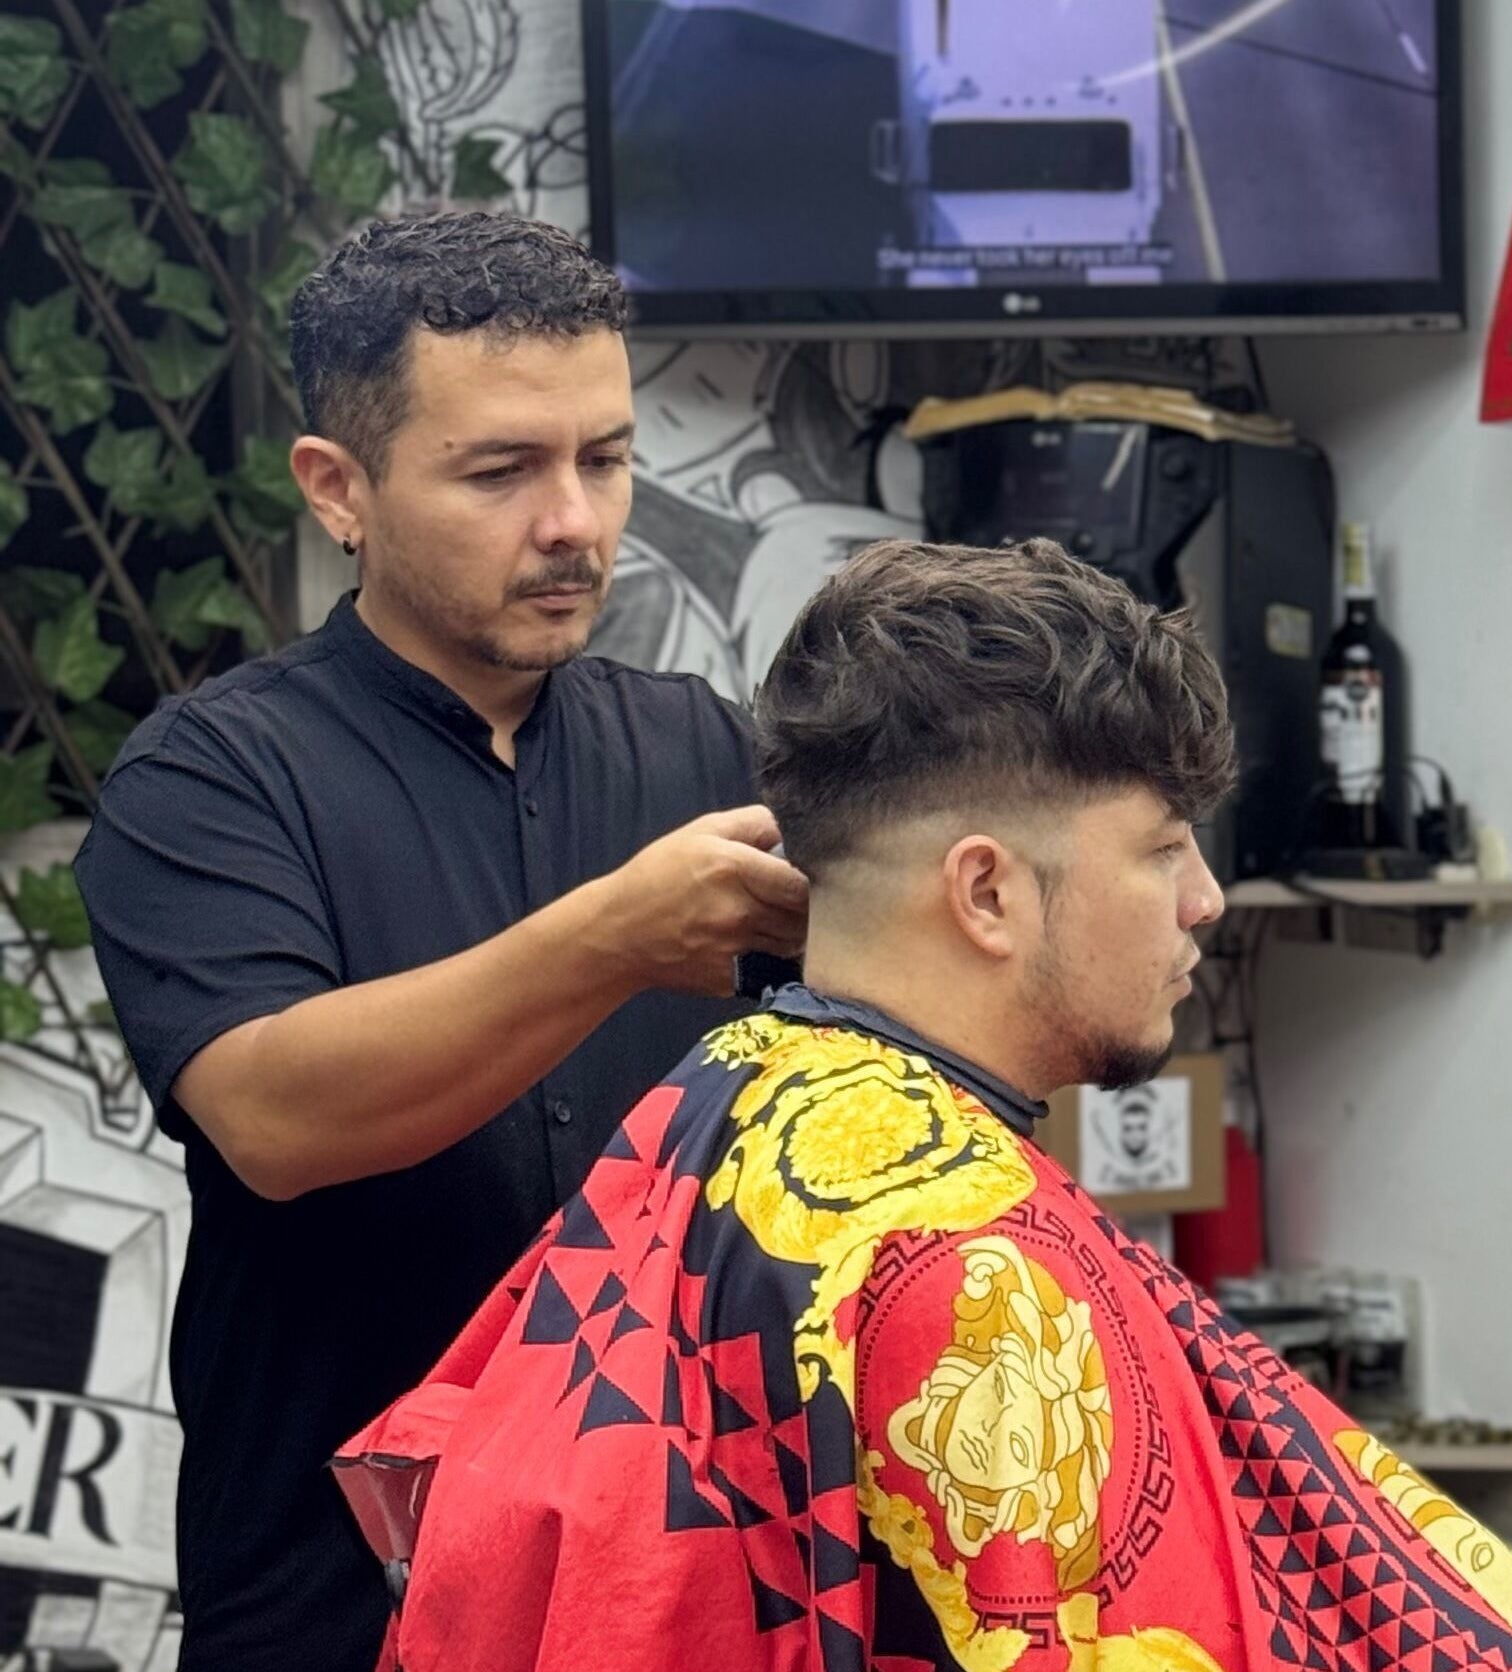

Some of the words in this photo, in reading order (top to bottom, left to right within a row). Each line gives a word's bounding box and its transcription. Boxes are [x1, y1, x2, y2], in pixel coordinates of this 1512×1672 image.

[877, 248, 914, 268] She
[917, 251, 973, 267] never
[976, 247, 1019, 267] took
[1023, 247, 1053, 267] her
[1059, 251, 1104, 273] eyes
[1107, 246, 1138, 267] off
[1141, 250, 1173, 267] me
